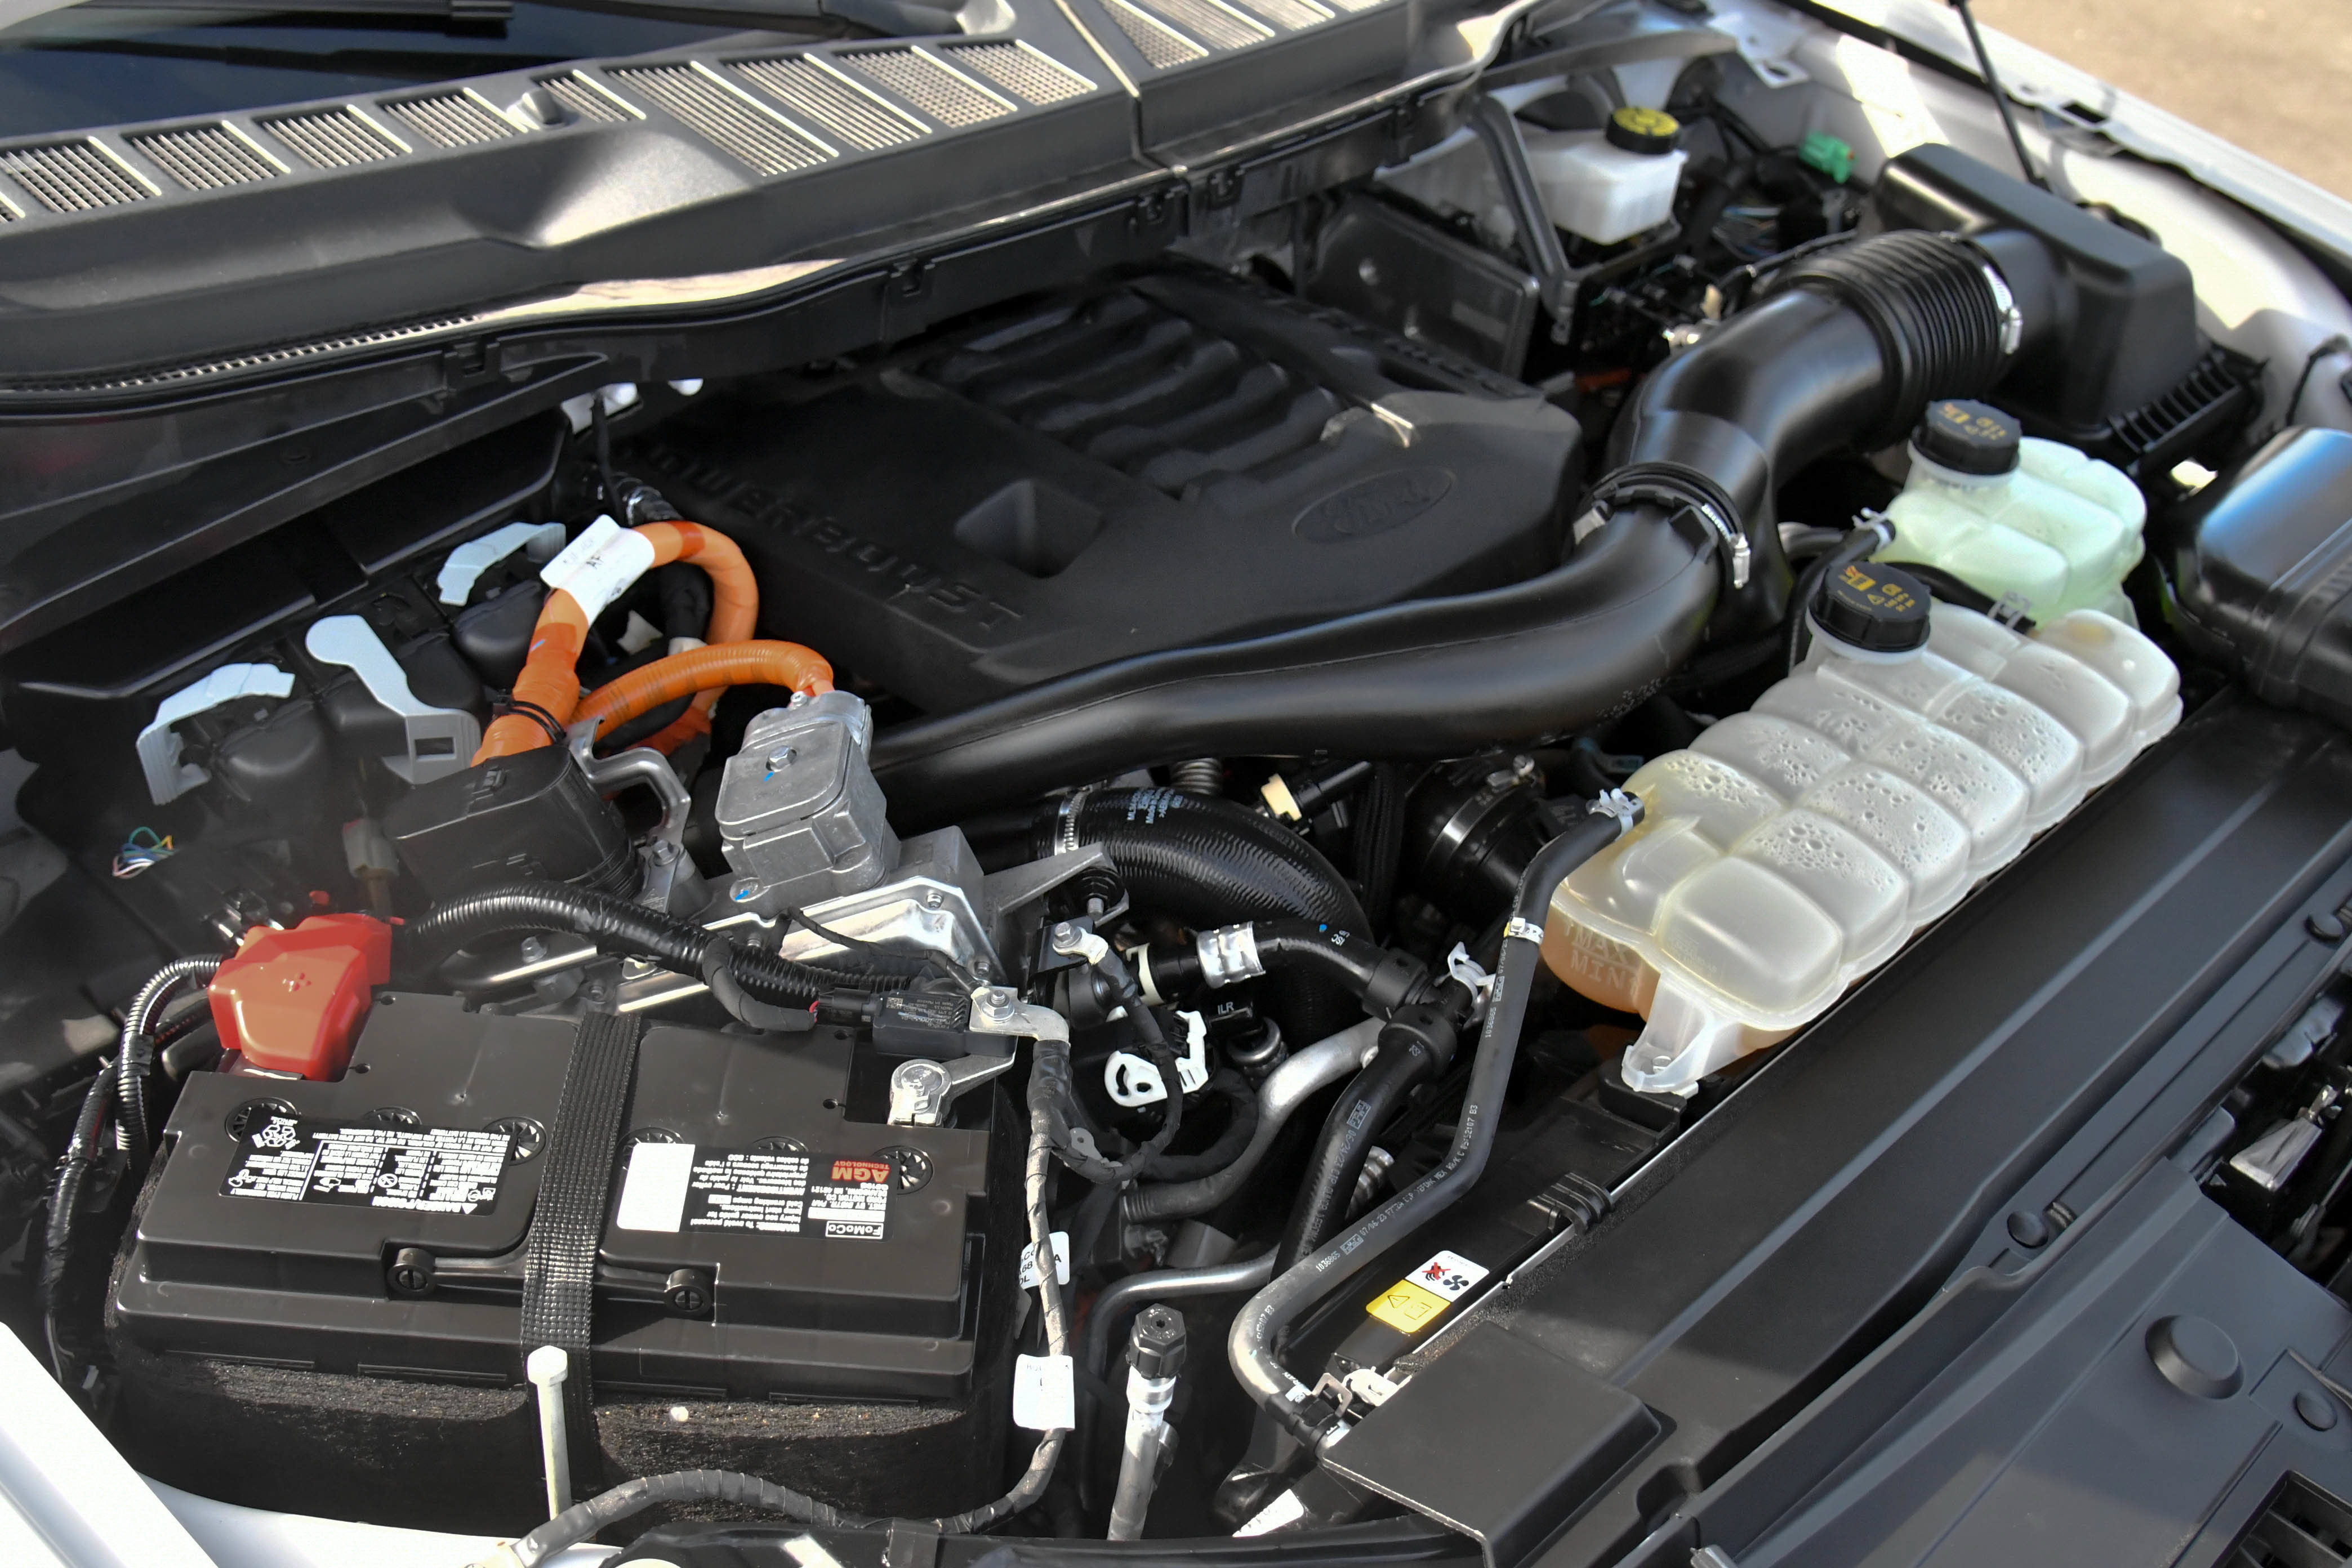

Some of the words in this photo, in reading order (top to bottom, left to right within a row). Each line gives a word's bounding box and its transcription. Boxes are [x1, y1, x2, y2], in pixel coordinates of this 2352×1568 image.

[627, 435, 1023, 632] OWERBOOST
[1575, 925, 1631, 965] MAX
[1571, 948, 1627, 990] MIN
[1217, 1001, 1235, 1015] ILR
[1469, 1104, 1478, 1115] B3
[834, 1161, 889, 1169] TECHNOLOGY
[832, 1167, 888, 1182] AGM
[828, 1224, 881, 1235] FoMoCo
